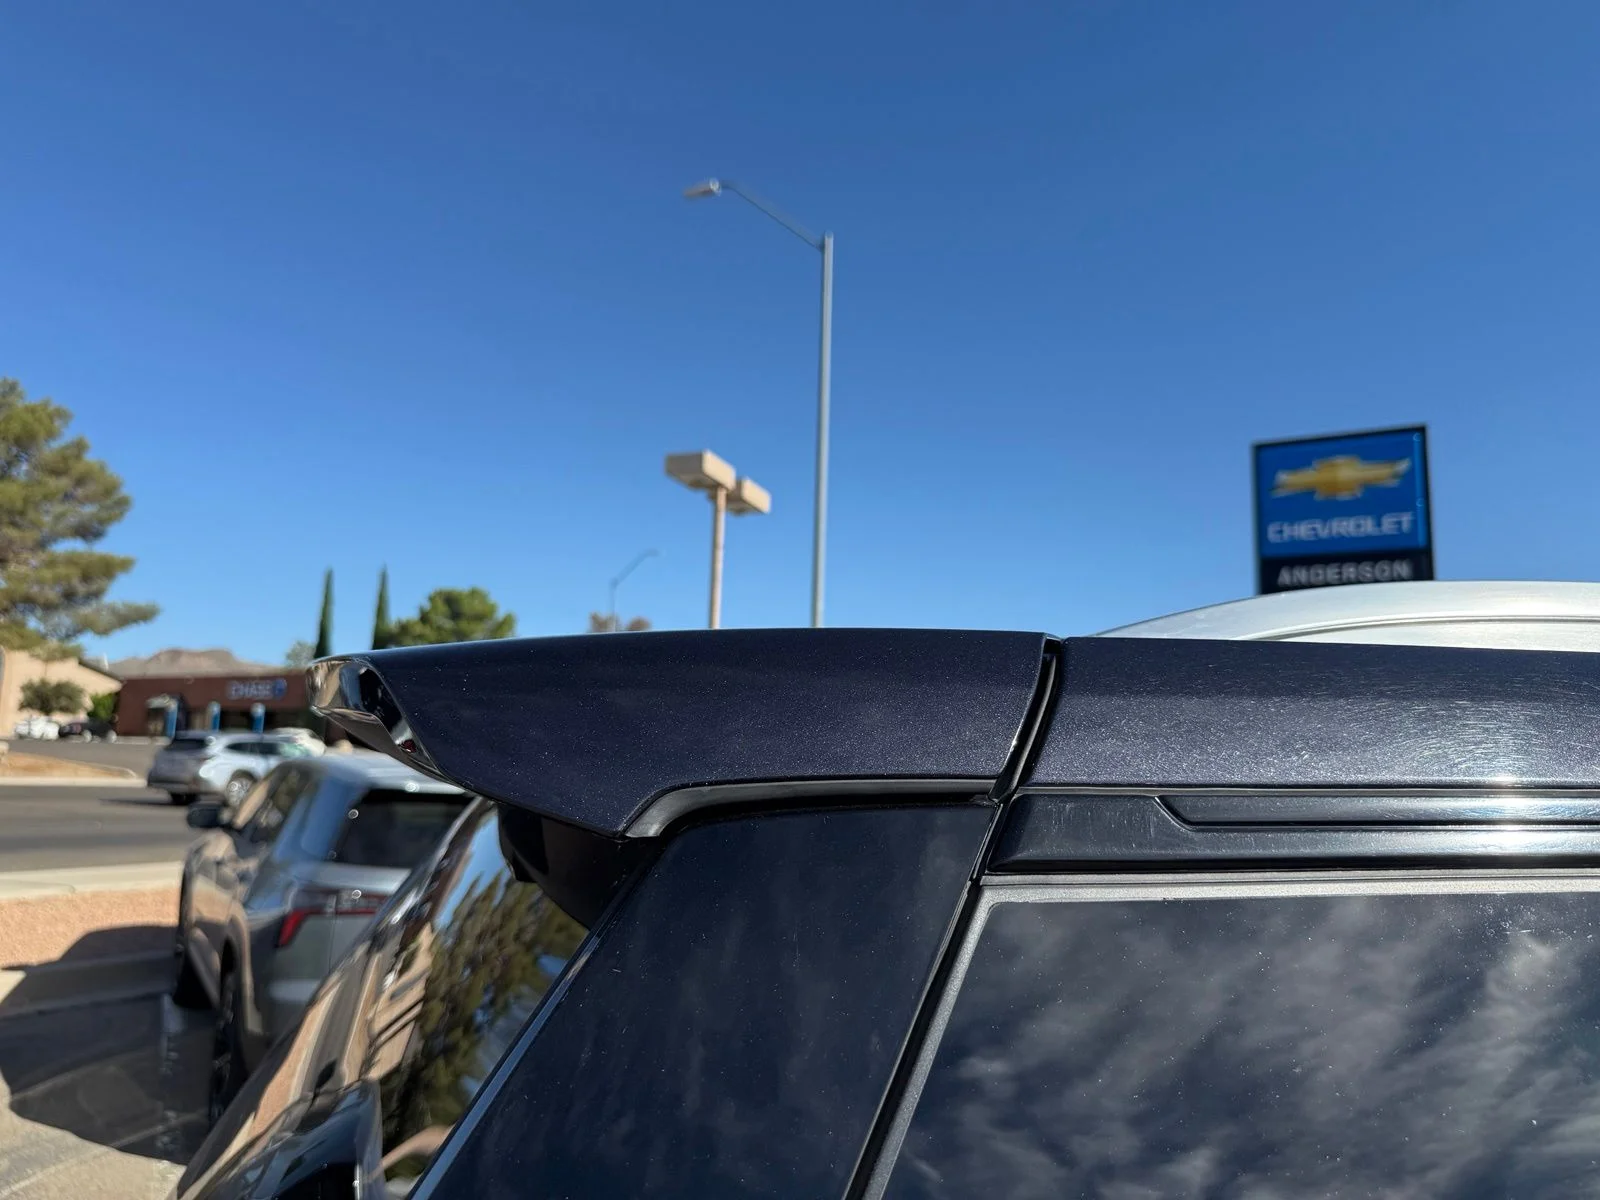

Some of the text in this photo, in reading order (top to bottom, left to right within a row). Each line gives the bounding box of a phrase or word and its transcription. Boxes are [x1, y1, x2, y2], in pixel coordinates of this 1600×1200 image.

[1267, 511, 1413, 543] CHEVROLET
[1277, 559, 1412, 586] ANDERSON
[228, 680, 272, 699] CHASE
